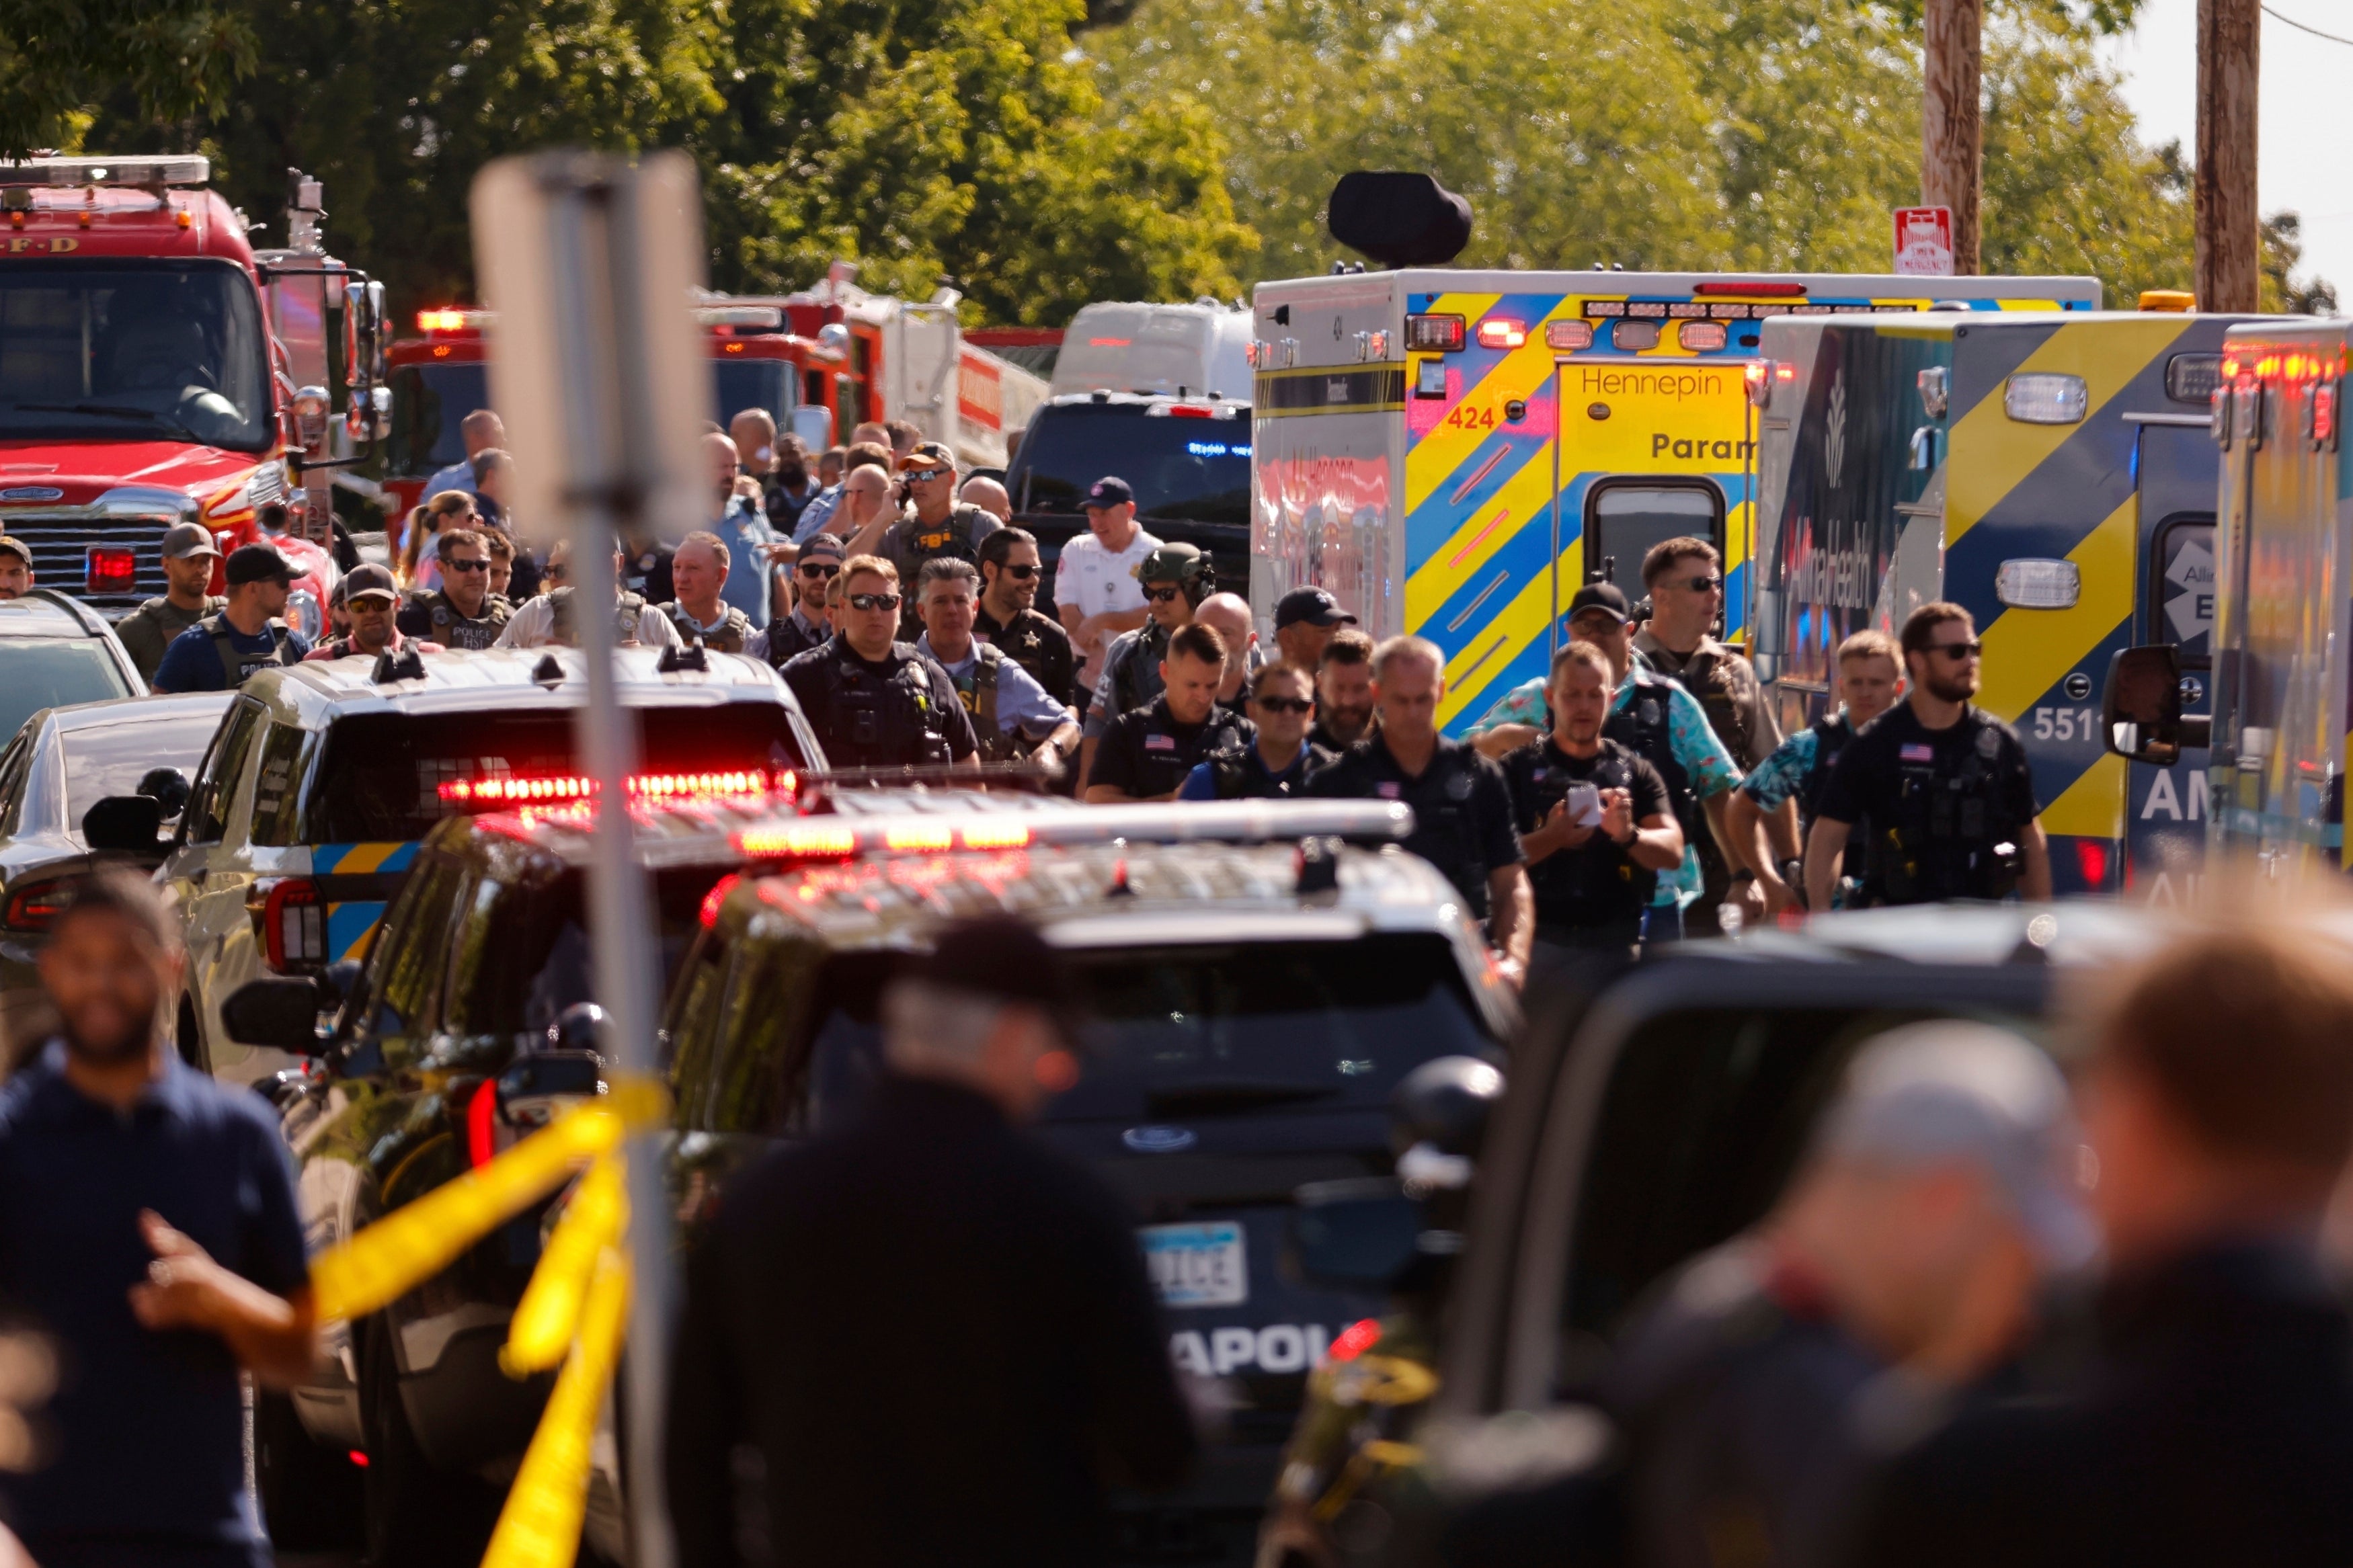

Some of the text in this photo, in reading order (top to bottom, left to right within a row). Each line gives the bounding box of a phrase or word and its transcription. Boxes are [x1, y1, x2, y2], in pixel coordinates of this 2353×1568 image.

[1583, 368, 1721, 403] Hennepin
[1447, 406, 1494, 429] 424
[919, 532, 951, 548] FBI
[453, 626, 491, 641] POLICE
[463, 636, 484, 651] HSI
[2034, 707, 2104, 741] 551
